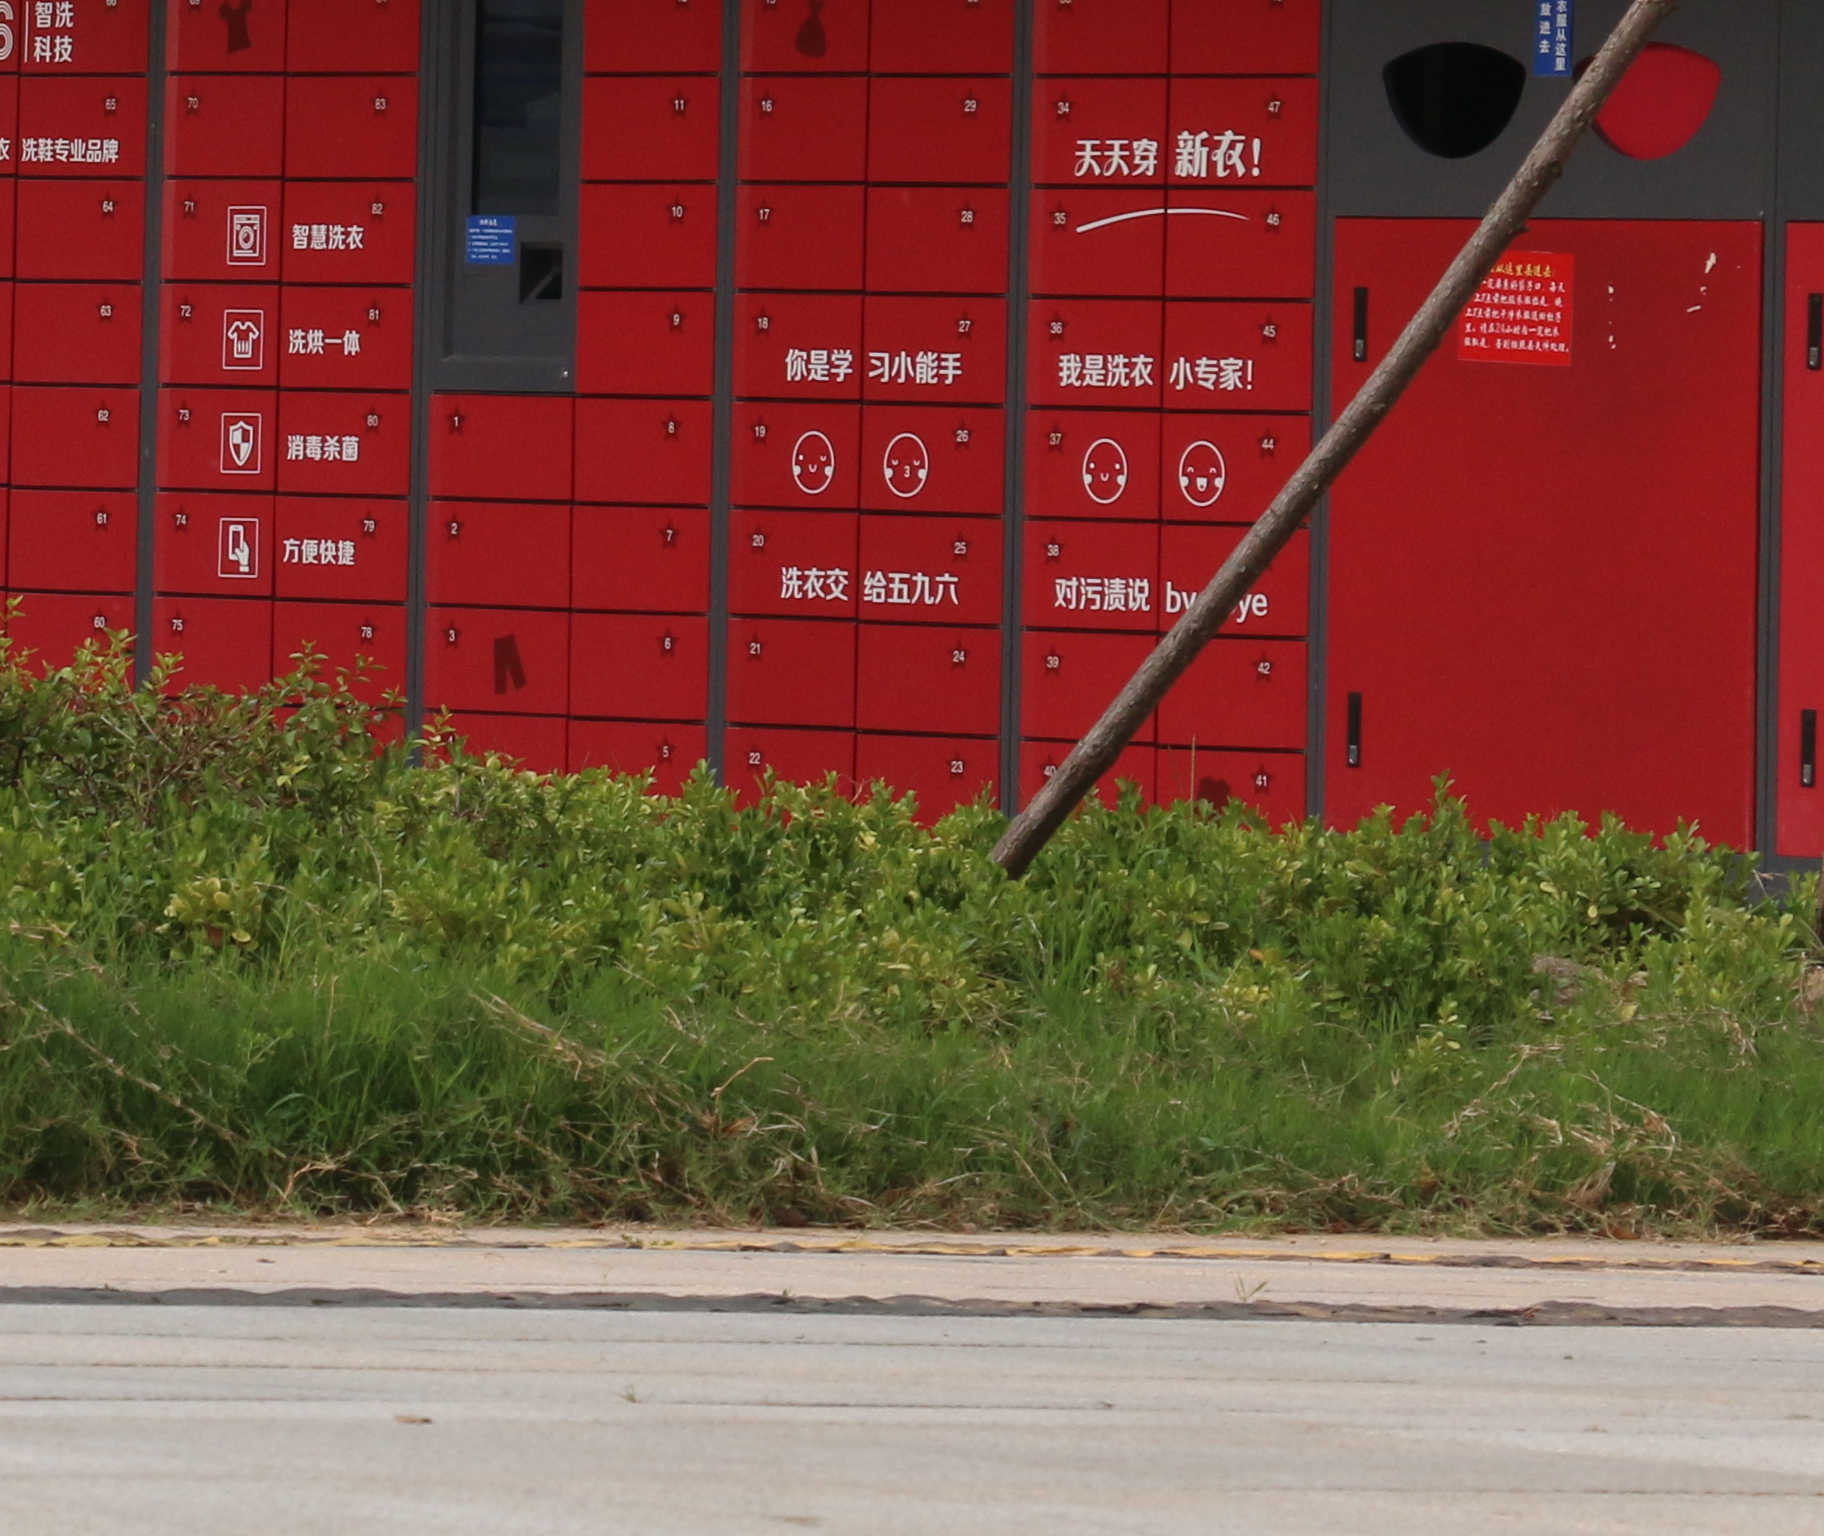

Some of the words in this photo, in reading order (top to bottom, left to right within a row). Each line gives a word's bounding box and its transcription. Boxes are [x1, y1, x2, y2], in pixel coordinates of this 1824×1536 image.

[34, 1, 73, 28] 智洗
[33, 35, 73, 63] 科技
[105, 98, 117, 110] 65
[187, 96, 199, 109] 70
[374, 97, 387, 110] 83
[674, 99, 685, 111] 11
[761, 99, 773, 113] 16
[963, 99, 977, 113] 29
[1057, 101, 1070, 115] 34
[1267, 100, 1281, 113] 47
[21, 138, 119, 163] 洗鞋专业品牌
[1074, 138, 1158, 177] 天天穿
[102, 200, 114, 213] 64
[183, 200, 195, 212] 71
[371, 202, 383, 215] 82
[671, 205, 683, 218] 10
[759, 208, 771, 221] 17
[960, 210, 974, 223] 28
[1053, 212, 1067, 225] 35
[1266, 213, 1280, 226] 46
[292, 224, 364, 250] 智慧洗衣
[100, 304, 112, 317] 63
[180, 304, 192, 317] 72
[368, 308, 379, 321] 81
[672, 313, 680, 326] 9
[757, 316, 769, 330] 18
[958, 320, 972, 333] 27
[1049, 321, 1063, 335] 36
[1262, 325, 1276, 338] 45
[288, 329, 361, 355] 洗烘一体
[785, 349, 853, 382] 你是学
[868, 351, 962, 384] 习小能手
[1059, 354, 1154, 388] 我是洗衣
[1169, 357, 1254, 391] 小专家!
[97, 409, 109, 422] 62
[178, 409, 190, 421] 73
[366, 414, 379, 427] 80
[452, 415, 460, 428] 1
[667, 421, 675, 434] 8
[754, 425, 766, 438] 19
[955, 429, 969, 443] 26
[1049, 432, 1062, 446] 37
[287, 435, 359, 462] 消毒杀菌
[1261, 438, 1275, 450] 44
[96, 512, 107, 525] 61
[175, 513, 187, 526] 74
[363, 519, 375, 533] 79
[450, 522, 458, 535] 2
[666, 529, 674, 542] 7
[751, 534, 765, 547] 20
[283, 539, 355, 566] 方便快捷
[954, 541, 967, 555] 25
[1047, 544, 1060, 557] 38
[781, 566, 849, 601] 洗衣交
[863, 571, 959, 605] 给五九六
[1054, 577, 1150, 612] 对污渍说
[93, 616, 105, 629] 60
[171, 618, 184, 631] 75
[361, 626, 373, 639] 78
[448, 629, 456, 642] 3
[664, 637, 672, 650] 6
[749, 642, 761, 655] 21
[952, 650, 965, 663] 24
[1046, 655, 1060, 669] 39
[1257, 661, 1271, 675] 42
[662, 745, 669, 758] 5
[748, 752, 761, 765] 22
[950, 760, 964, 774] 23
[1043, 764, 1057, 778] 40
[1255, 774, 1267, 787] 41
